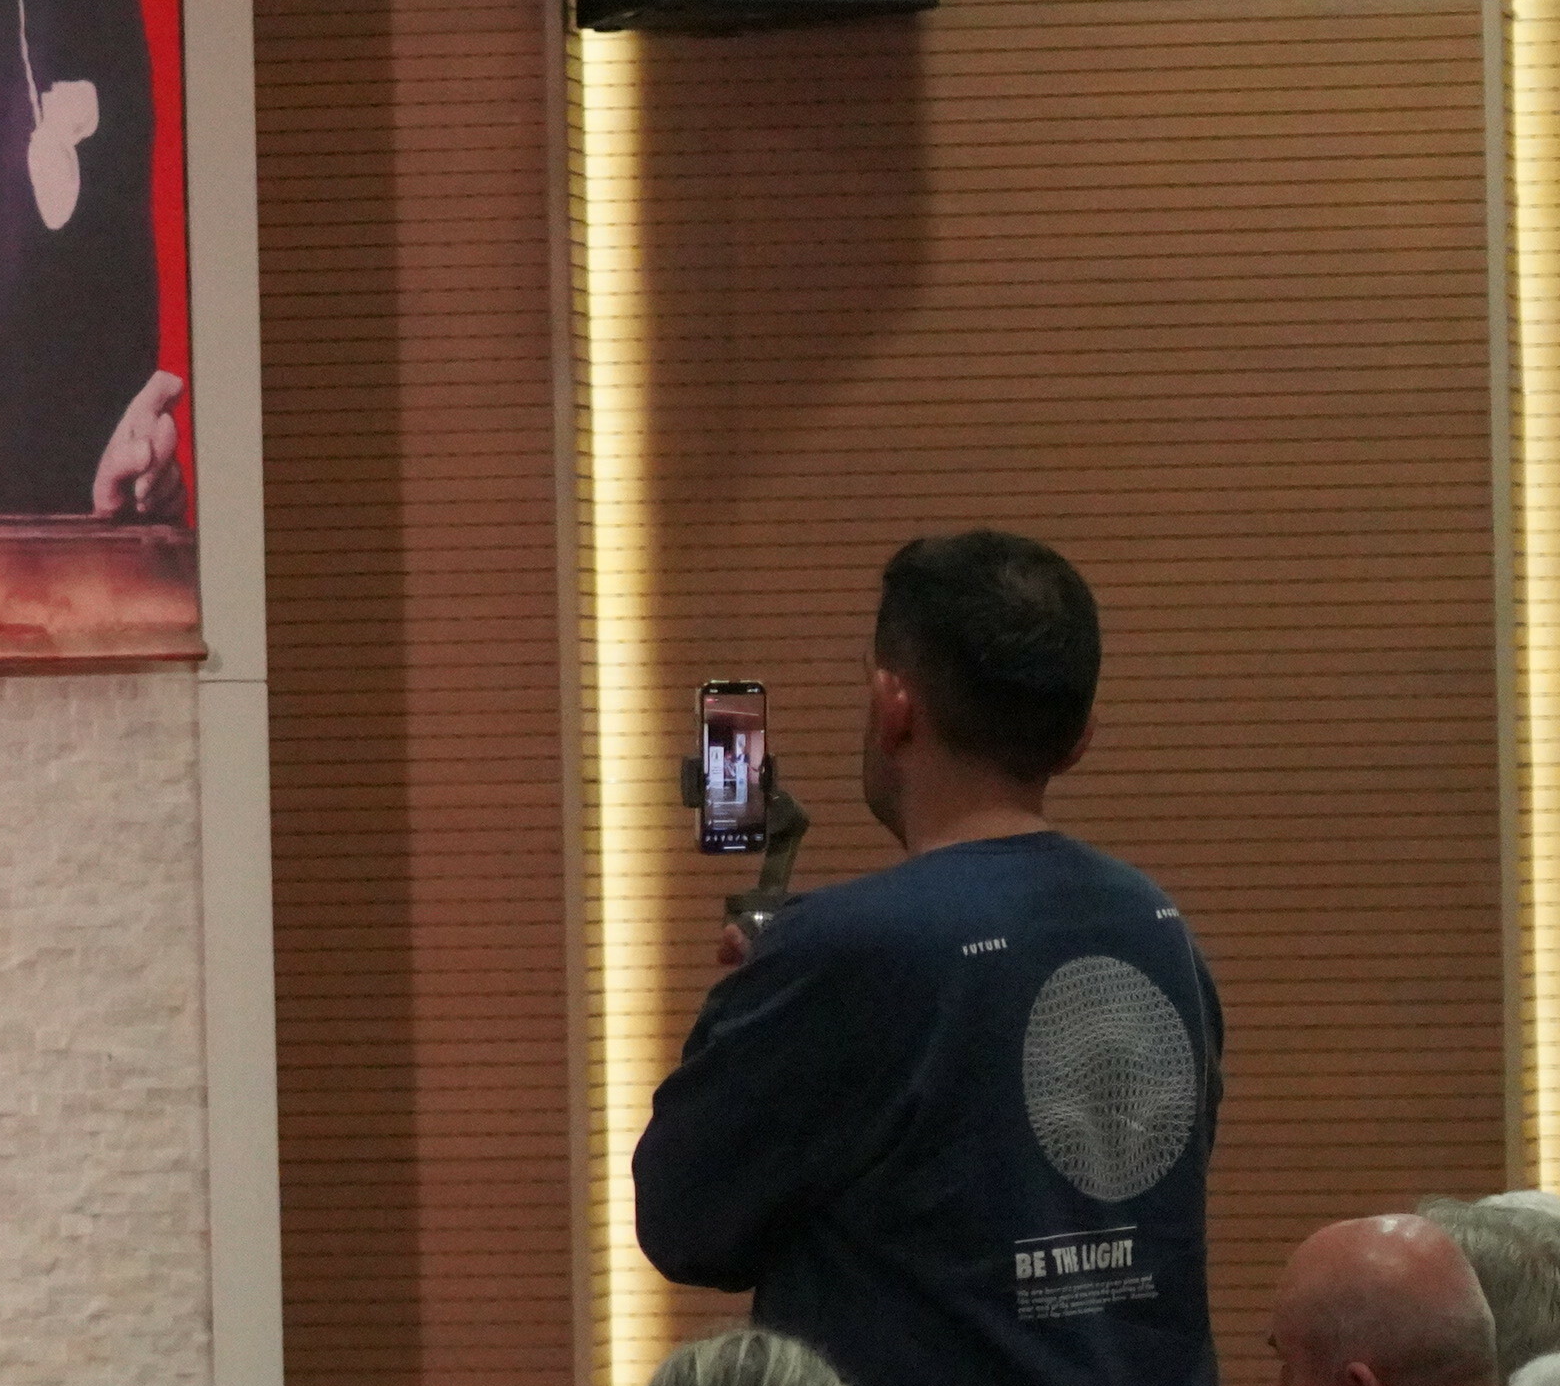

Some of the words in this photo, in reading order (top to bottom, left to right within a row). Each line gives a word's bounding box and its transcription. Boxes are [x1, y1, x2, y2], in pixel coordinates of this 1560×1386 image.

[1015, 1251, 1047, 1279] BE
[1051, 1245, 1080, 1275] THE
[1082, 1239, 1133, 1271] LIGHT
